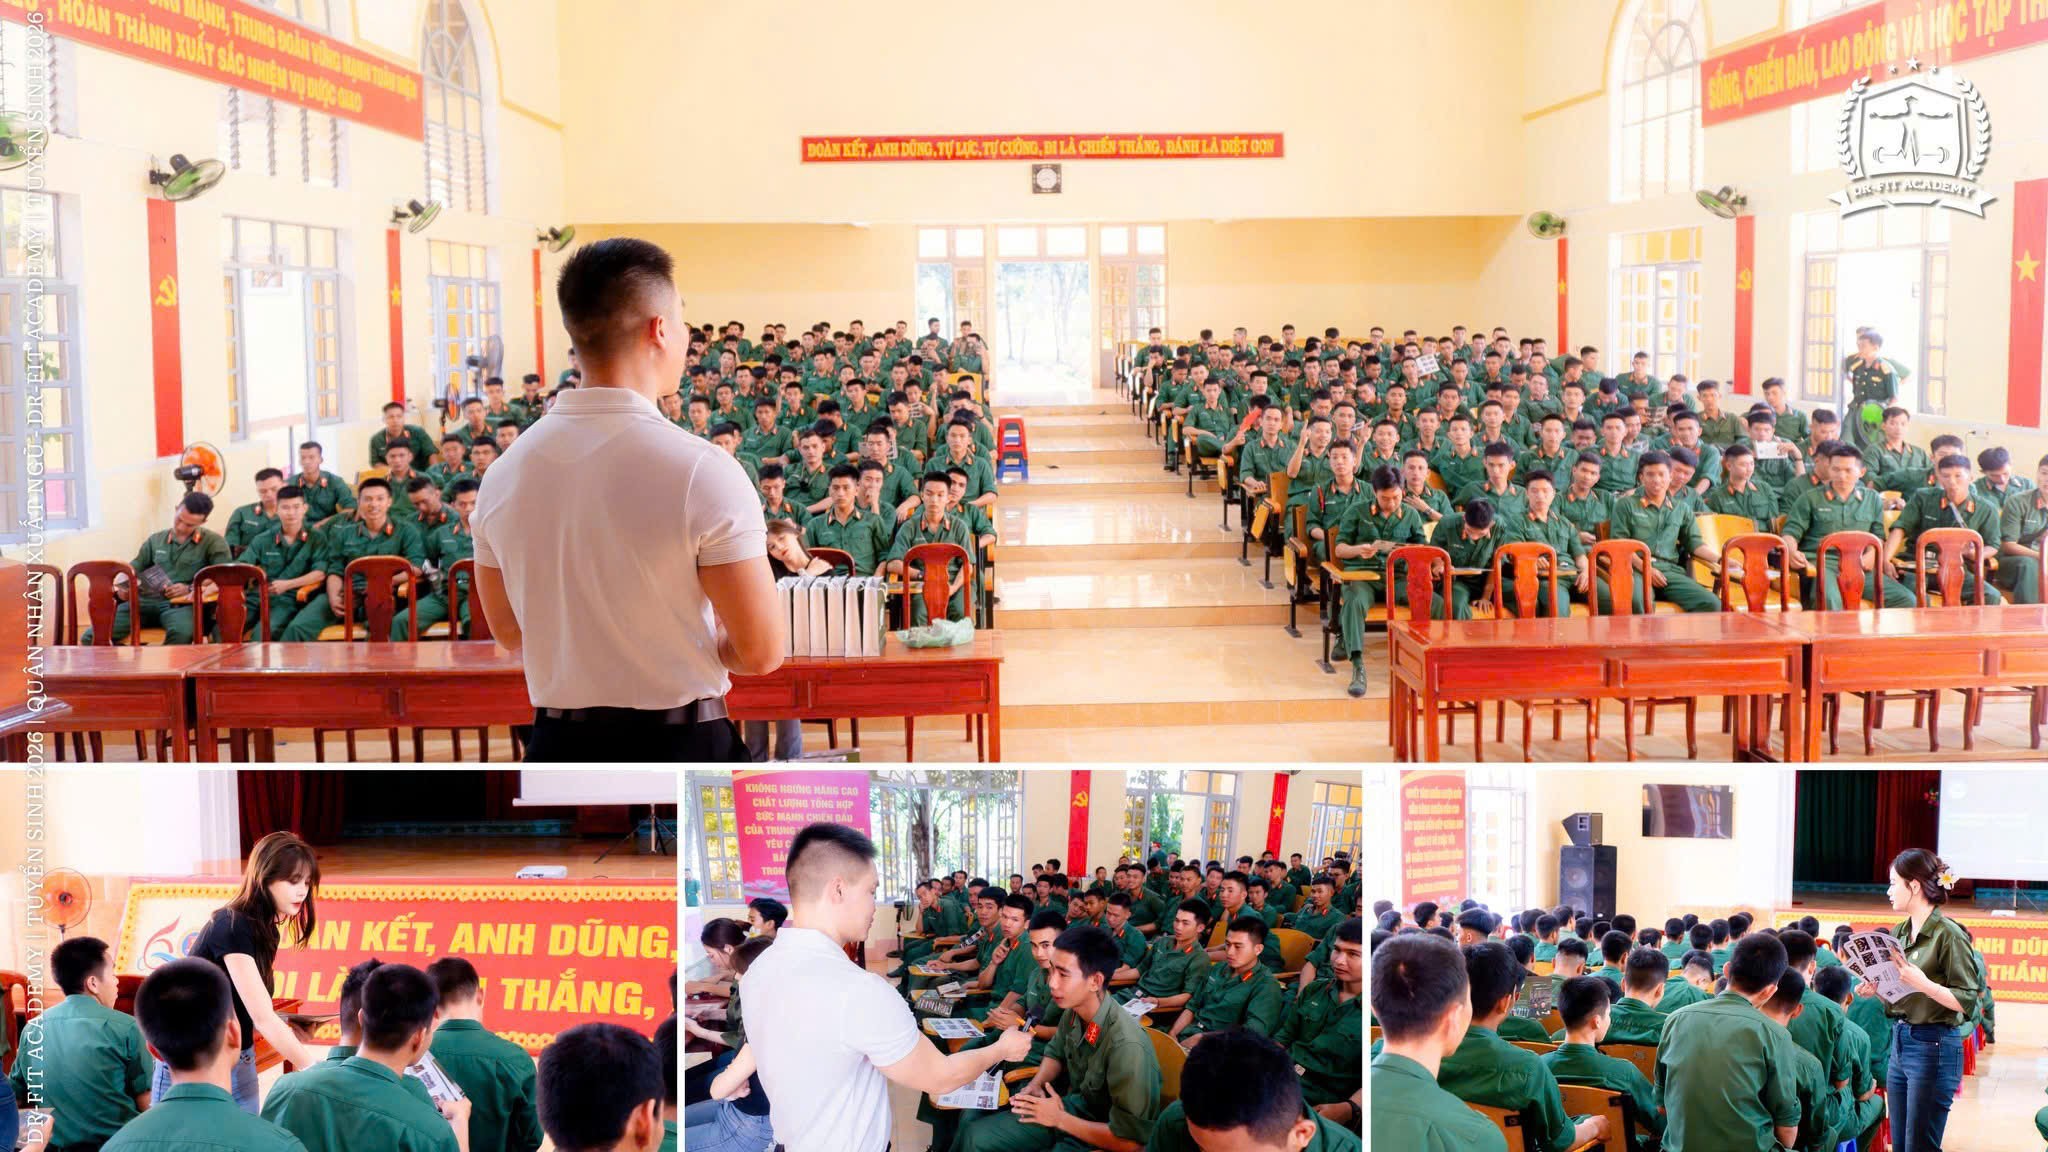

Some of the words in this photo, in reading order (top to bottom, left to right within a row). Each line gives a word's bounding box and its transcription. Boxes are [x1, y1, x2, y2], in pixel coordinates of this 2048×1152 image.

[114, 13, 172, 55] THÀNH
[231, 10, 276, 49] TRUNG
[1821, 36, 1850, 79] LAO
[1901, 2, 1924, 57] VÀ
[874, 142, 899, 157] ANH
[841, 786, 859, 796] CAO
[761, 866, 786, 876] TRON
[359, 912, 436, 957] KẾT,
[448, 922, 536, 955] ANH
[548, 918, 677, 963] DŨNG,
[1974, 937, 2006, 955] NH
[1988, 959, 2048, 983] THẮN
[501, 968, 655, 1020] THẮNG,
